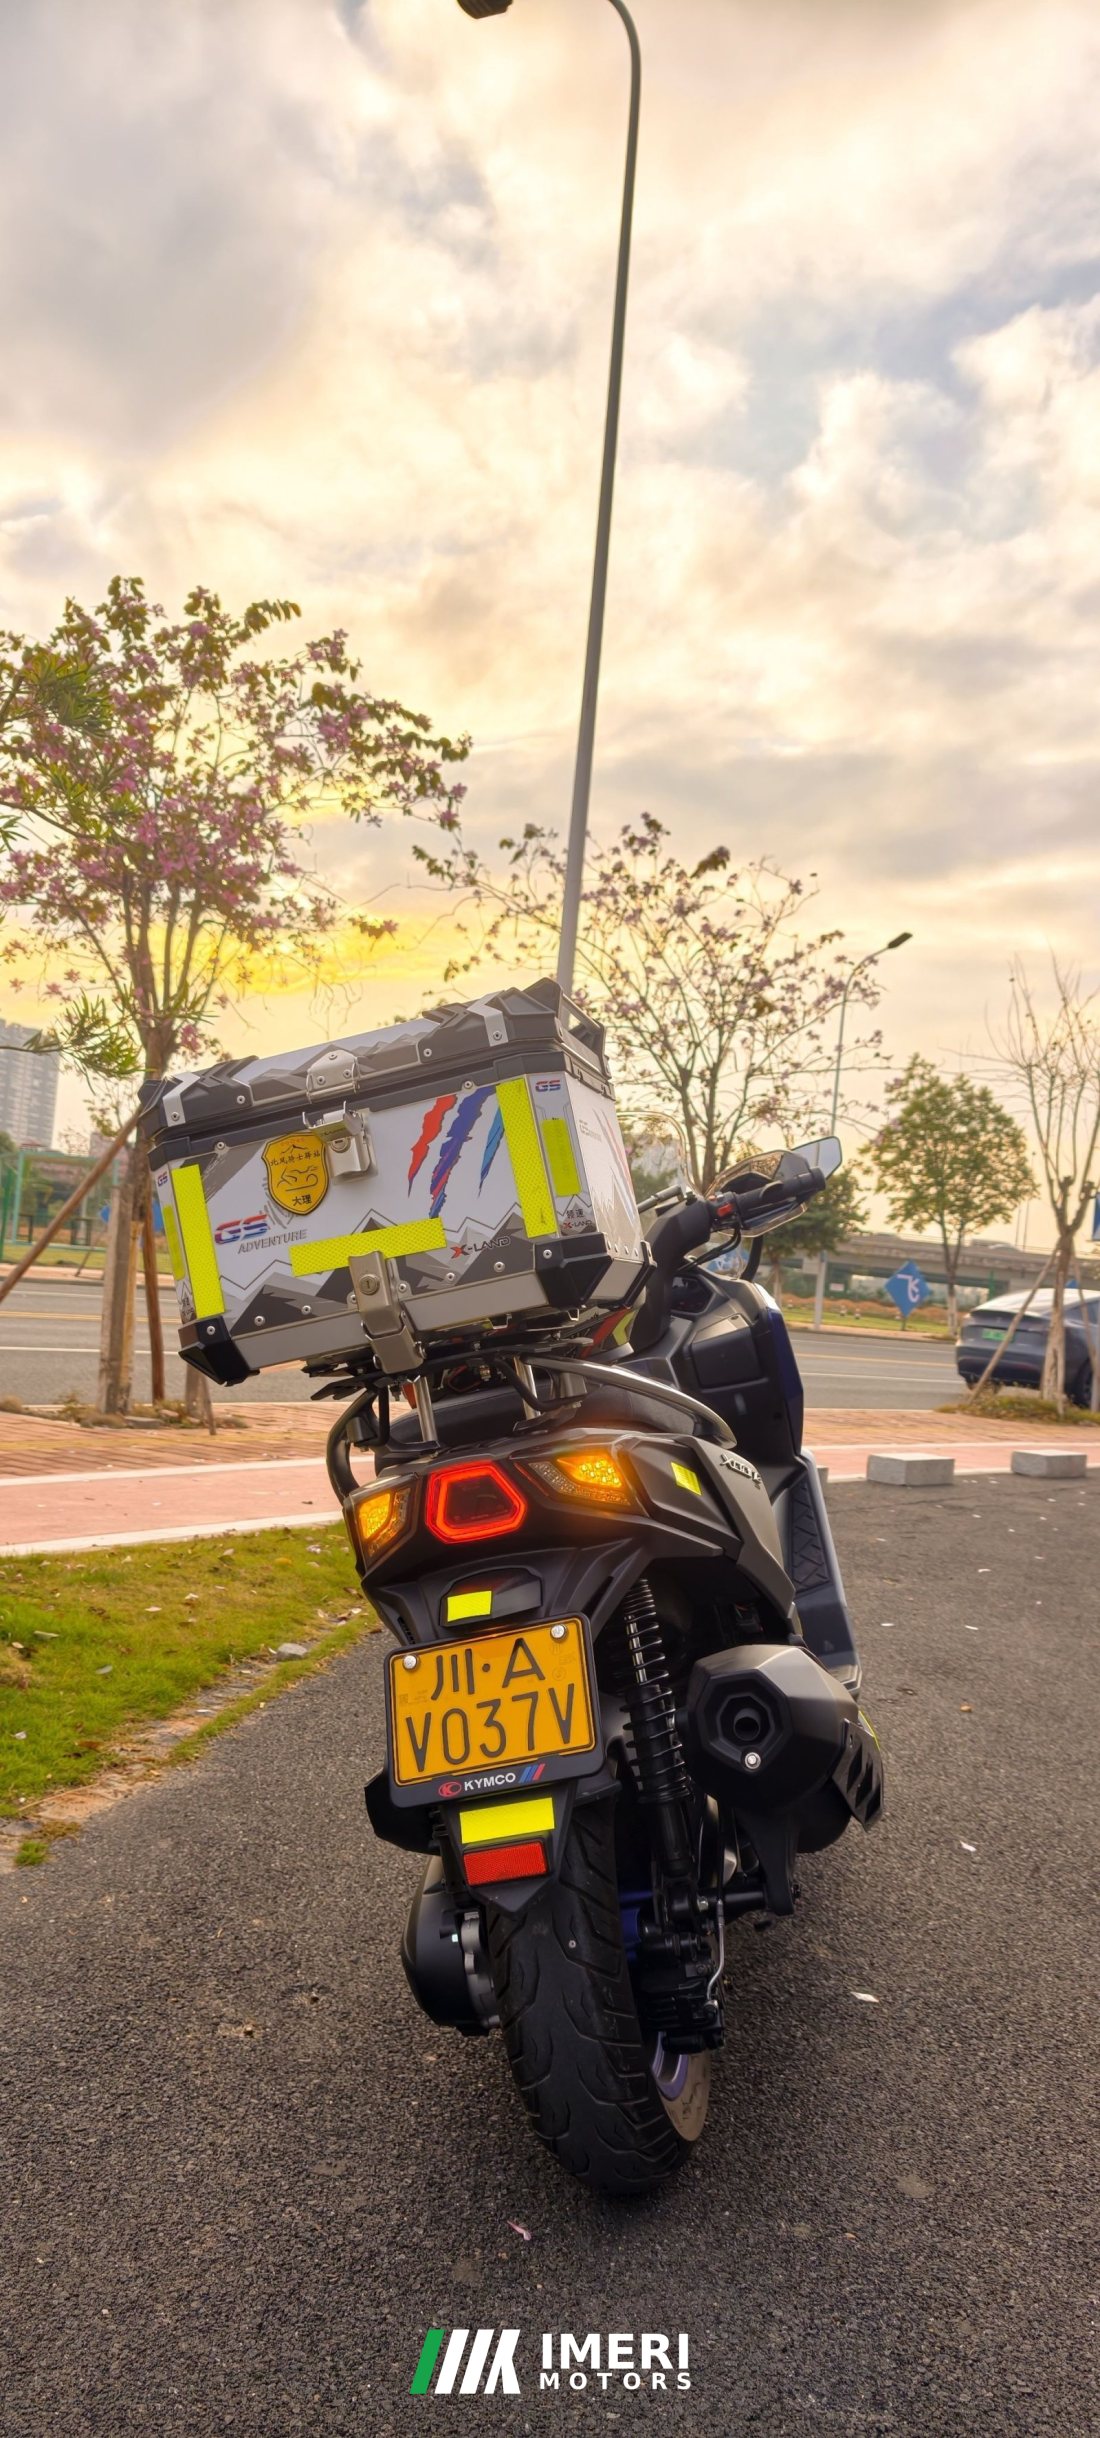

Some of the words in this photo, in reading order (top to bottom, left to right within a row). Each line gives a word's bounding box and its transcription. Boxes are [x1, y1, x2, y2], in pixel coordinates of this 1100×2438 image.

[536, 1080, 561, 1092] GS
[292, 1194, 313, 1207] 大理
[214, 1213, 270, 1245] GS
[238, 1229, 308, 1254] ADVENTURE
[450, 1235, 511, 1260] X-LAND
[405, 1683, 575, 1773] V037V
[464, 1772, 517, 1791] KYMCO
